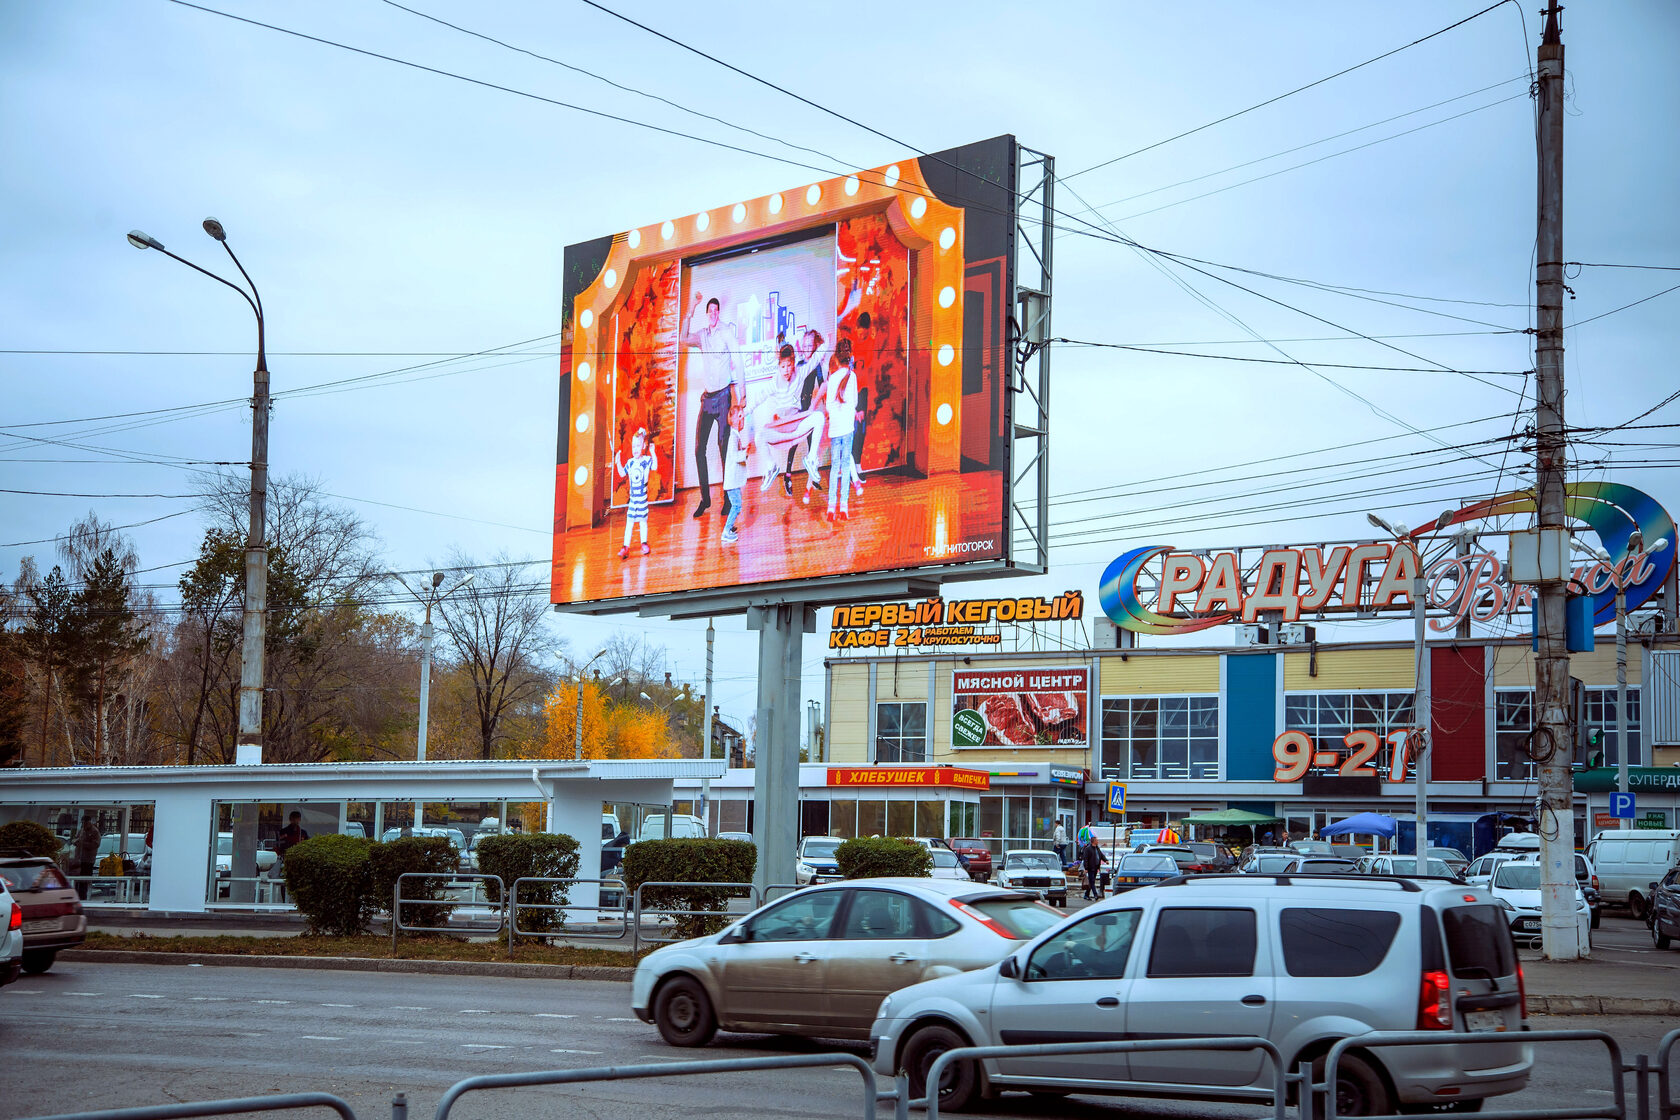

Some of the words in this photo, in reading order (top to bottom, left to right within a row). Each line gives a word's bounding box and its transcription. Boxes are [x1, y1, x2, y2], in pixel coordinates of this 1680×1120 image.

[1157, 542, 1417, 623] РАДУГА
[832, 598, 943, 628] ПЕРВЫЙ
[947, 591, 1082, 623] КЕГОВЫЙ
[829, 630, 890, 648] КАФЕ
[895, 628, 922, 646] 24
[923, 635, 1000, 645] КРУГЛОСУТОЧНО
[924, 626, 974, 636] РАБОТАЕМ
[958, 674, 1024, 689] МЯСНОЙ
[1030, 675, 1082, 689] ЦЕНТР
[954, 723, 981, 743] СВЕЖЕЕ
[958, 714, 984, 734] ВСЕГДА
[1272, 729, 1409, 782] 9-21
[849, 771, 925, 783] ХЛЕБУШЕК
[953, 773, 986, 785] ВЫПЕЧКА
